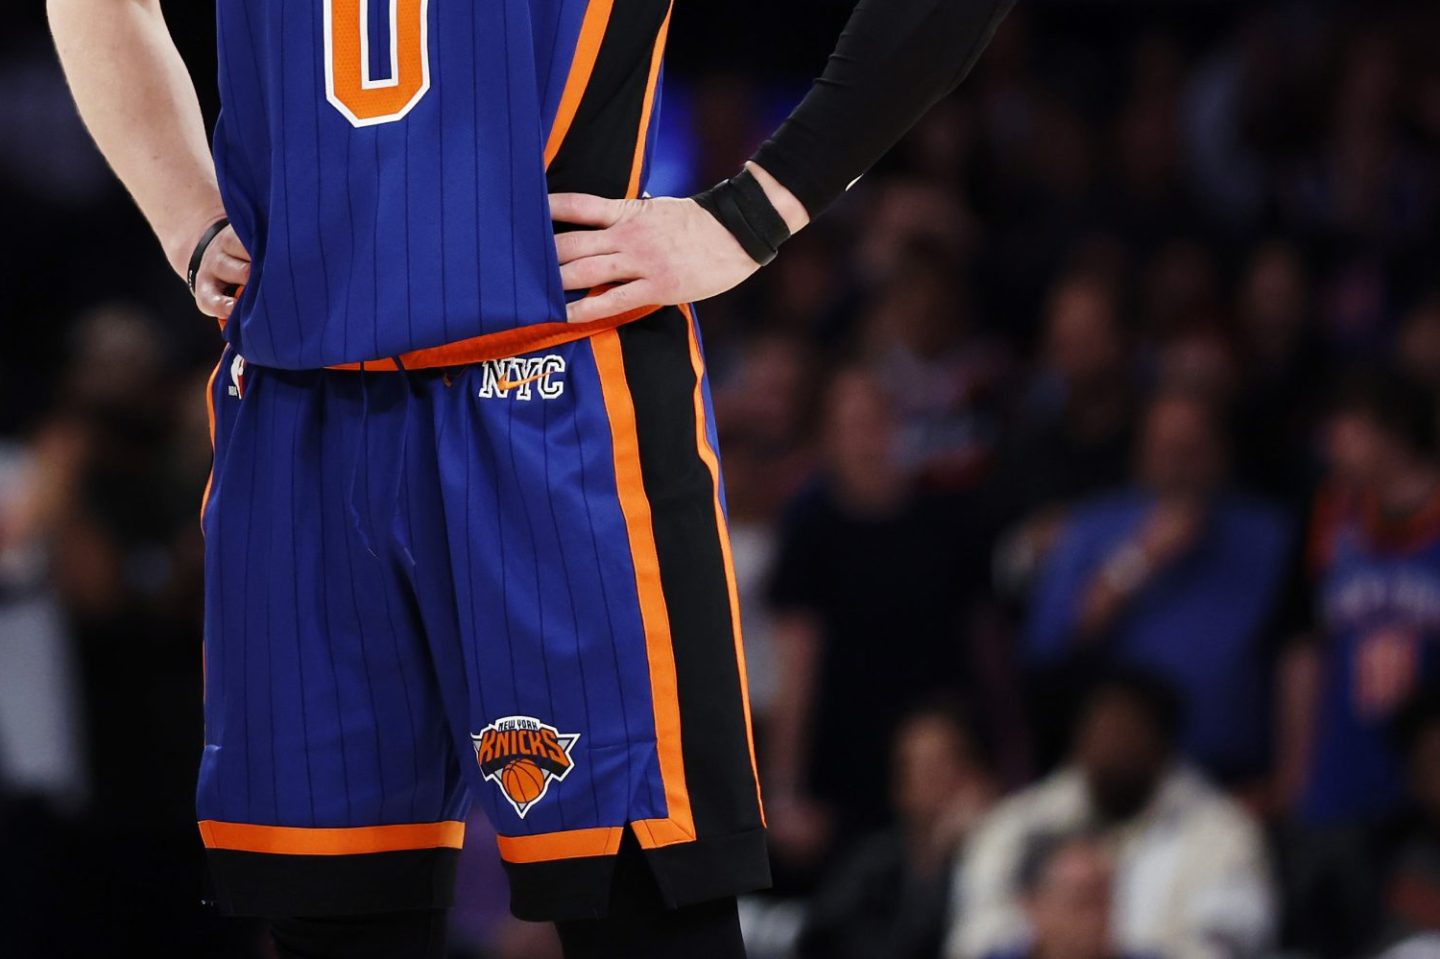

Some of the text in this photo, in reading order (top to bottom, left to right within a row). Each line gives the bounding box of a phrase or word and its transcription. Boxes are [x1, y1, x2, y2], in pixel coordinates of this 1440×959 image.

[479, 354, 566, 401] NYC
[497, 720, 539, 731] NEW YORK
[478, 727, 571, 767] KNICKS
